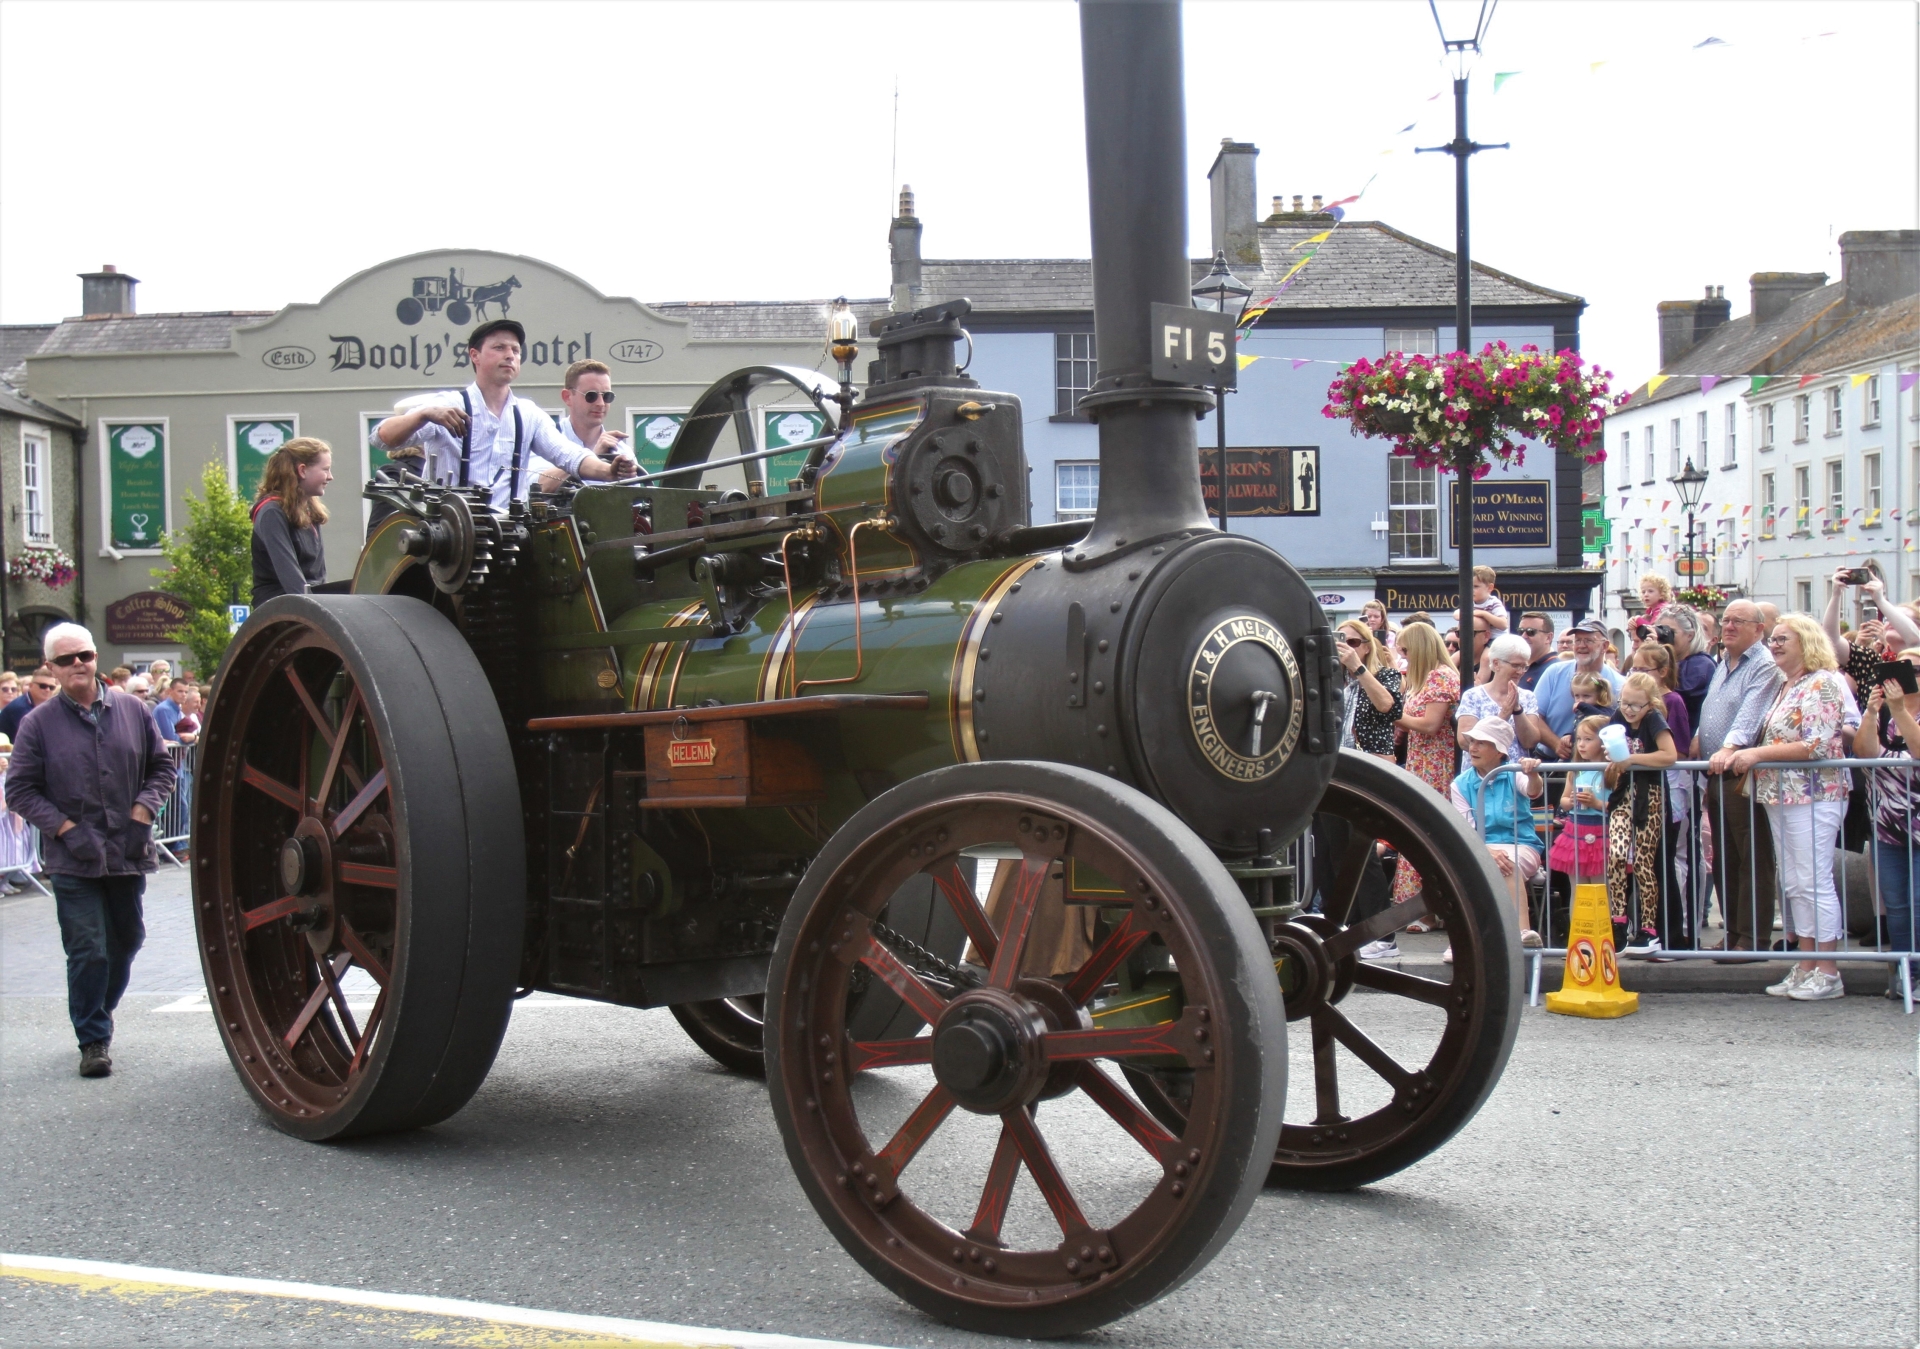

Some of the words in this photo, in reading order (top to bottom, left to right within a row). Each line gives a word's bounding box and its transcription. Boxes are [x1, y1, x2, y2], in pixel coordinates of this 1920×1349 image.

[328, 332, 470, 377] Dooly's
[620, 344, 653, 359] 1747
[1207, 331, 1227, 365] 5
[270, 350, 309, 366] Estd.
[769, 477, 783, 487] Hot
[1497, 510, 1543, 522] WINNING
[1497, 525, 1505, 534] &
[1507, 525, 1544, 534] OPTICIANS
[1386, 588, 1460, 610] PHARMAC
[115, 597, 151, 619] Coffee
[154, 596, 185, 618] Shop
[236, 609, 244, 622] P
[1202, 649, 1218, 664] &
[1214, 629, 1229, 648] H
[1192, 704, 1265, 779] ENGINEERS
[1278, 698, 1303, 762] LEEDS
[673, 745, 711, 761] HELENA
